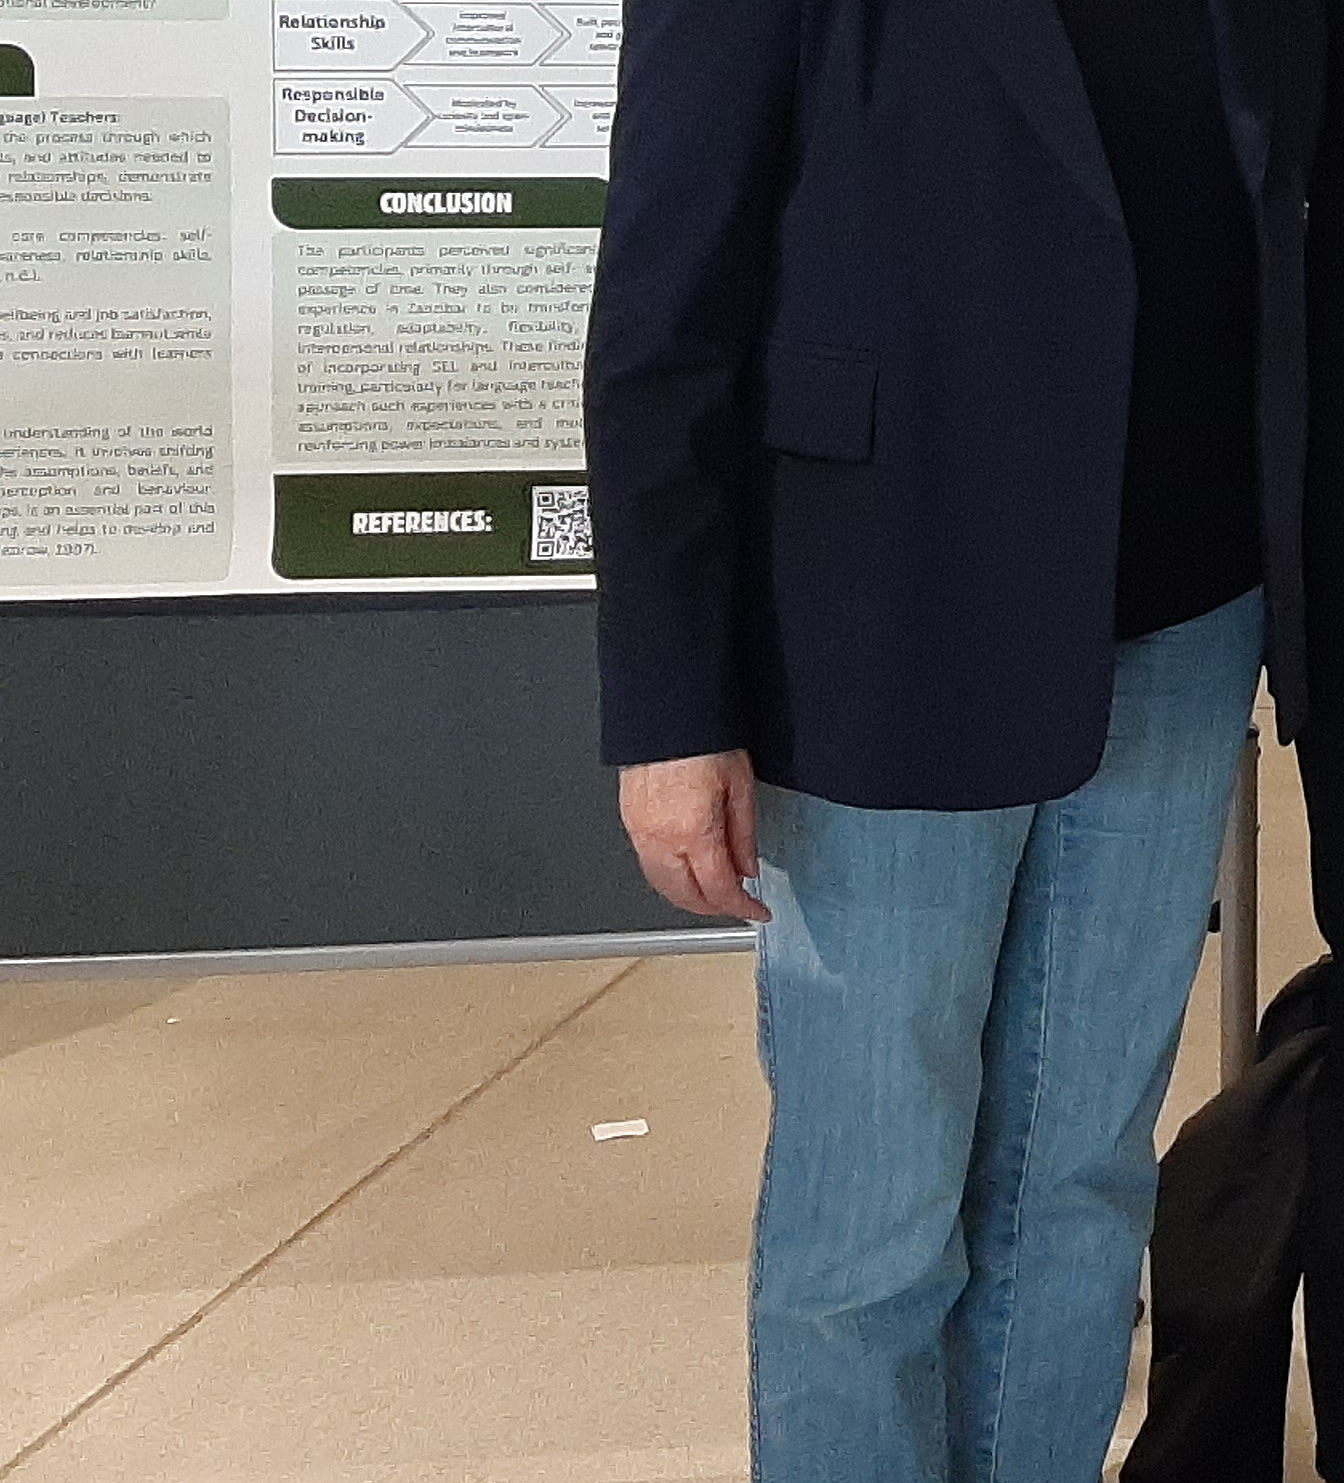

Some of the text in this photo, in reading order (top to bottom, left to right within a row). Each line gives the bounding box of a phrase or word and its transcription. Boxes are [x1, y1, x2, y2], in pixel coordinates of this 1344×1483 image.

[279, 14, 386, 31] Relationship
[310, 36, 356, 51] Skills
[281, 87, 385, 103] Responsible
[294, 108, 374, 123] Decision-
[302, 130, 365, 147] making
[379, 192, 513, 214] CONCLUSION
[352, 509, 493, 535] REFERENCES:
